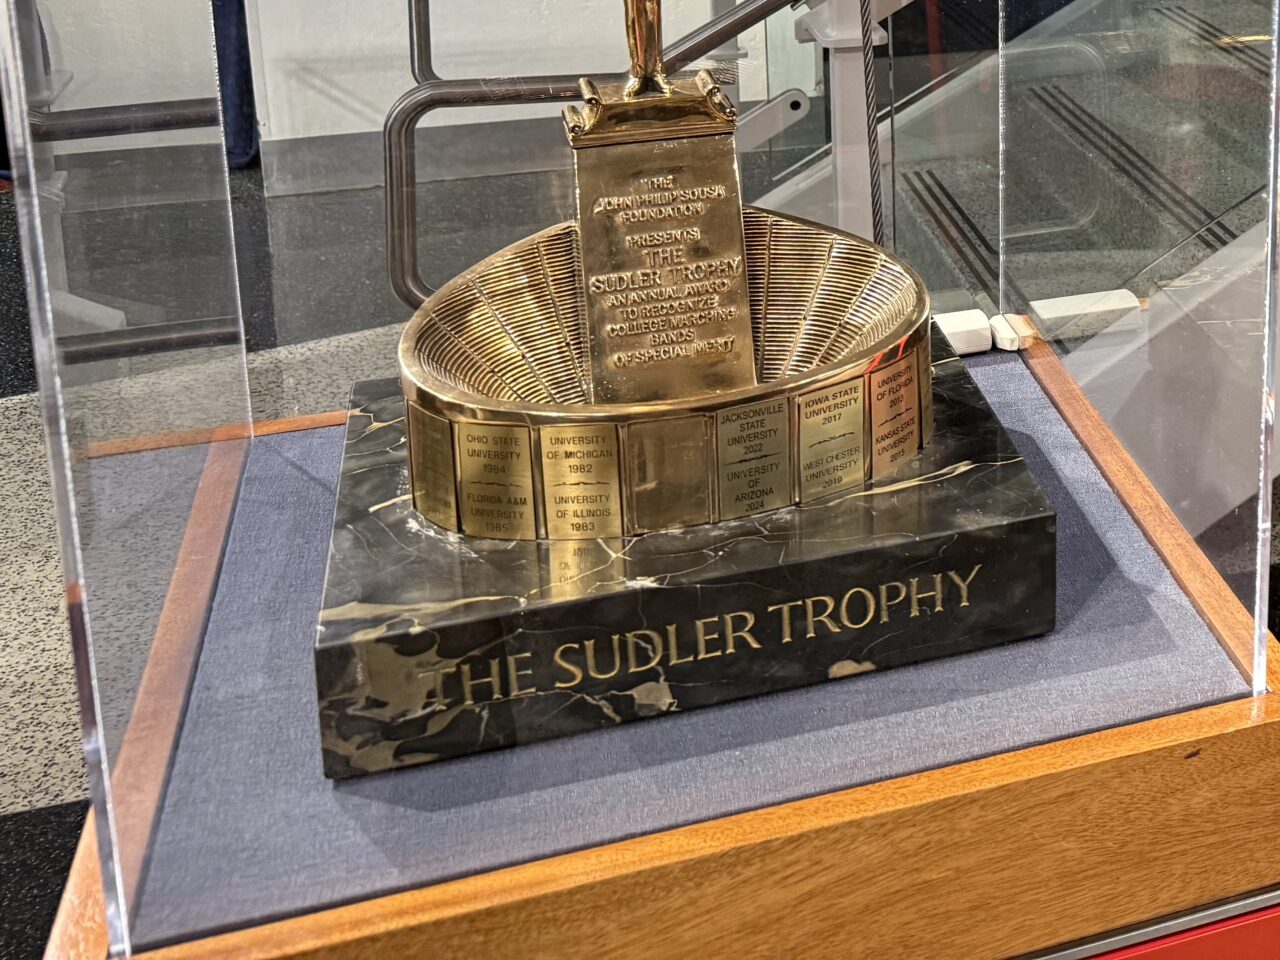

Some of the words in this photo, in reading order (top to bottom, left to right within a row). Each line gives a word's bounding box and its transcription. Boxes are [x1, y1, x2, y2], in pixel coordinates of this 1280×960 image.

[641, 175, 675, 190] THE
[594, 196, 634, 214] JOHN
[634, 192, 678, 208] PHILIP
[680, 185, 726, 203] SOUSA
[618, 202, 704, 224] FOUNDATION
[626, 227, 701, 248] PRESENTS
[642, 246, 686, 266] THE
[590, 269, 661, 292] SUDLER
[670, 256, 742, 282] TROPHY
[606, 292, 628, 307] AN
[628, 286, 682, 304] ANNUAL
[683, 279, 731, 297] AWARD
[619, 305, 638, 319] TO
[642, 295, 720, 317] RECOGNIZE
[606, 316, 668, 337] COLLEGE
[669, 306, 738, 329] MARCHING
[614, 351, 633, 368] OF
[635, 343, 691, 363] SPECIAL
[878, 364, 912, 388] UNIVERSITY
[804, 396, 830, 409] IOWA
[832, 385, 860, 400] STATE
[877, 390, 887, 401] OF
[888, 376, 913, 396] FLORIDA
[720, 403, 785, 425] JACKSONVILLE
[805, 396, 859, 420] UNIVERSITY
[739, 420, 766, 433] STATE
[821, 413, 842, 426] 2017
[467, 434, 488, 445] OHIO
[493, 436, 520, 447] STATE
[727, 428, 779, 447] UNIVERSITY
[875, 426, 900, 444] KANSAS
[901, 417, 916, 432] STATE
[550, 436, 607, 446] UNIVERSITY
[743, 443, 763, 454] 2022
[877, 430, 914, 456] UNIVERSITY
[467, 448, 521, 460] UNIVERSITY
[546, 450, 560, 460] OF
[564, 449, 613, 460] MICHIGAN
[802, 458, 825, 472] WEST
[826, 446, 861, 464] CHESTER
[568, 463, 593, 474] 1982
[726, 462, 781, 482] UNIVERSITY
[805, 459, 858, 482] UNIVERSITY
[748, 478, 761, 489] OF
[822, 475, 843, 490] 2019
[467, 493, 502, 505] FLORIDA
[506, 497, 527, 506] A&M
[554, 494, 611, 505] UNIVERSITY
[734, 488, 774, 503] ARIZONA
[471, 507, 524, 519] UNIVERSITY
[556, 509, 570, 519] OF
[573, 508, 611, 518] ILLINOIS
[745, 501, 765, 512] 2024
[571, 521, 596, 532] 1983
[424, 652, 537, 711] THE
[554, 610, 763, 690] SUDLER
[768, 563, 984, 644] TROPHY
